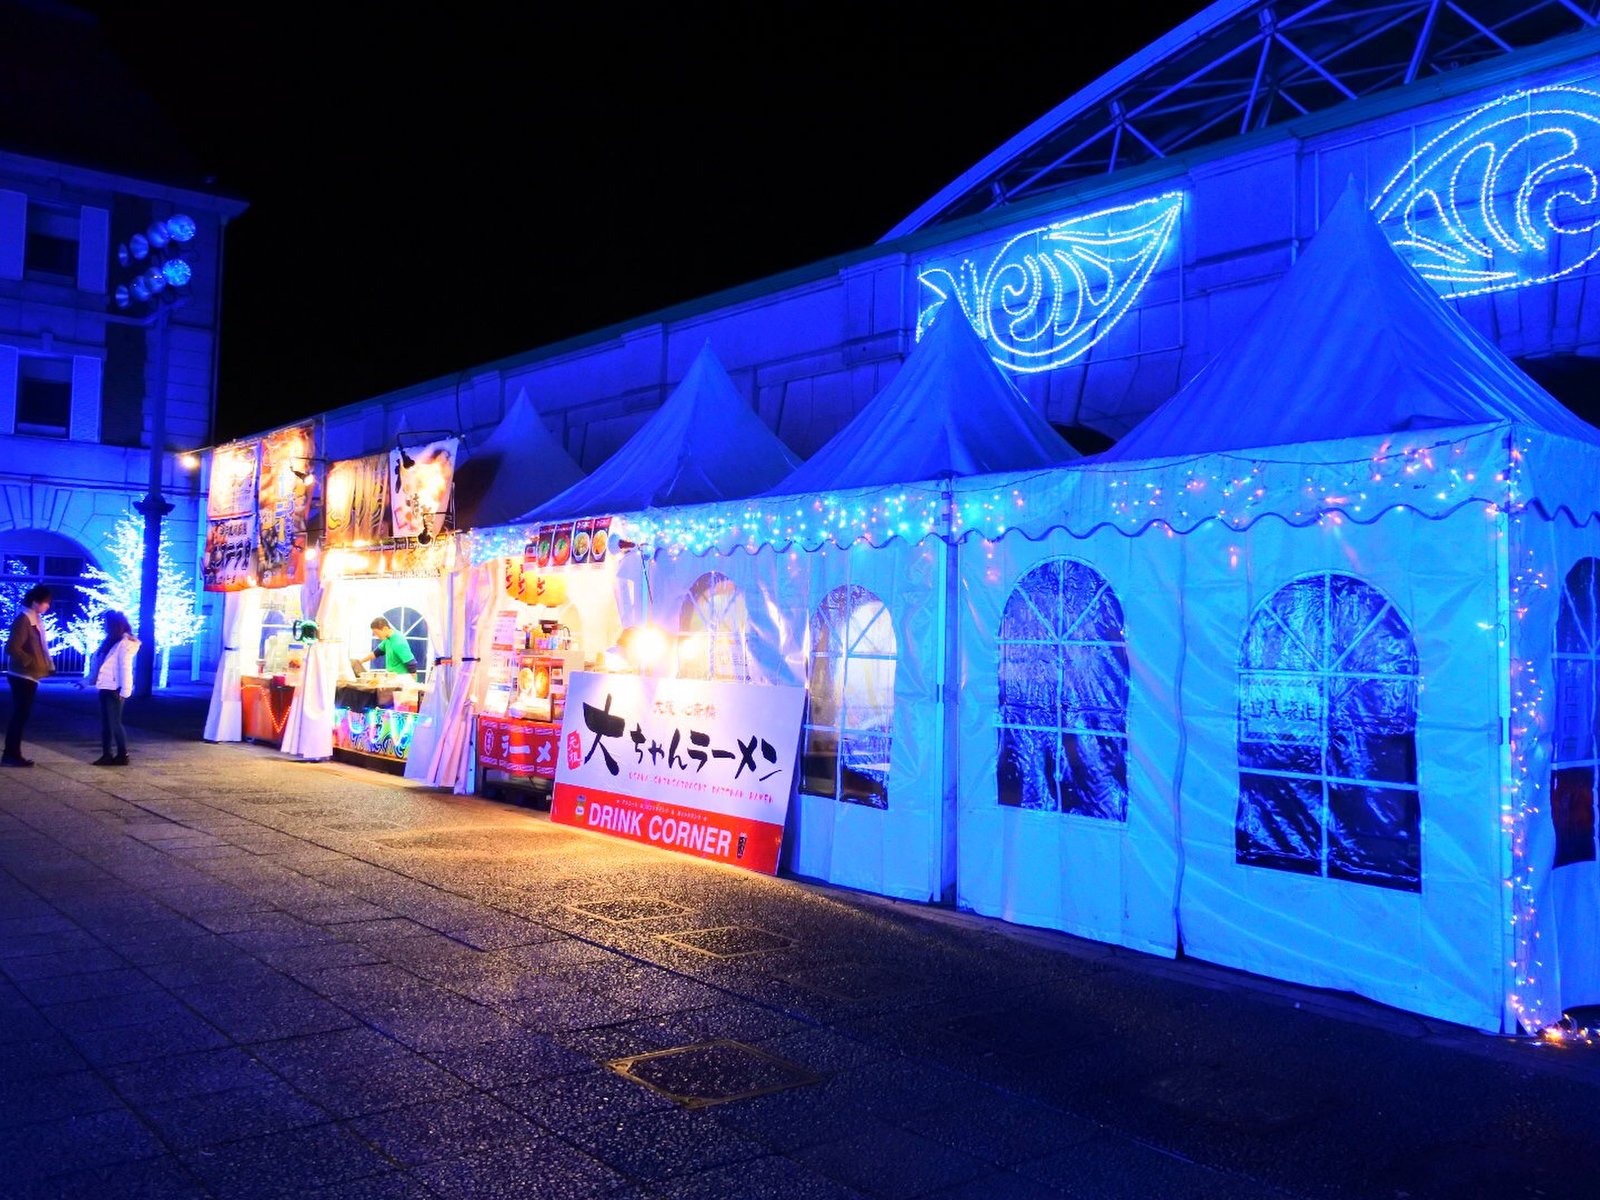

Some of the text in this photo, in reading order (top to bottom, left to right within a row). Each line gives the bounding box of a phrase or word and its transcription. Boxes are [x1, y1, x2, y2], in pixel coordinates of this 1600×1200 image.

[501, 735, 560, 763] ラーメ
[583, 693, 782, 781] 大ちゃんラーメン
[587, 802, 644, 837] DRINK
[648, 815, 733, 857] CORNER
